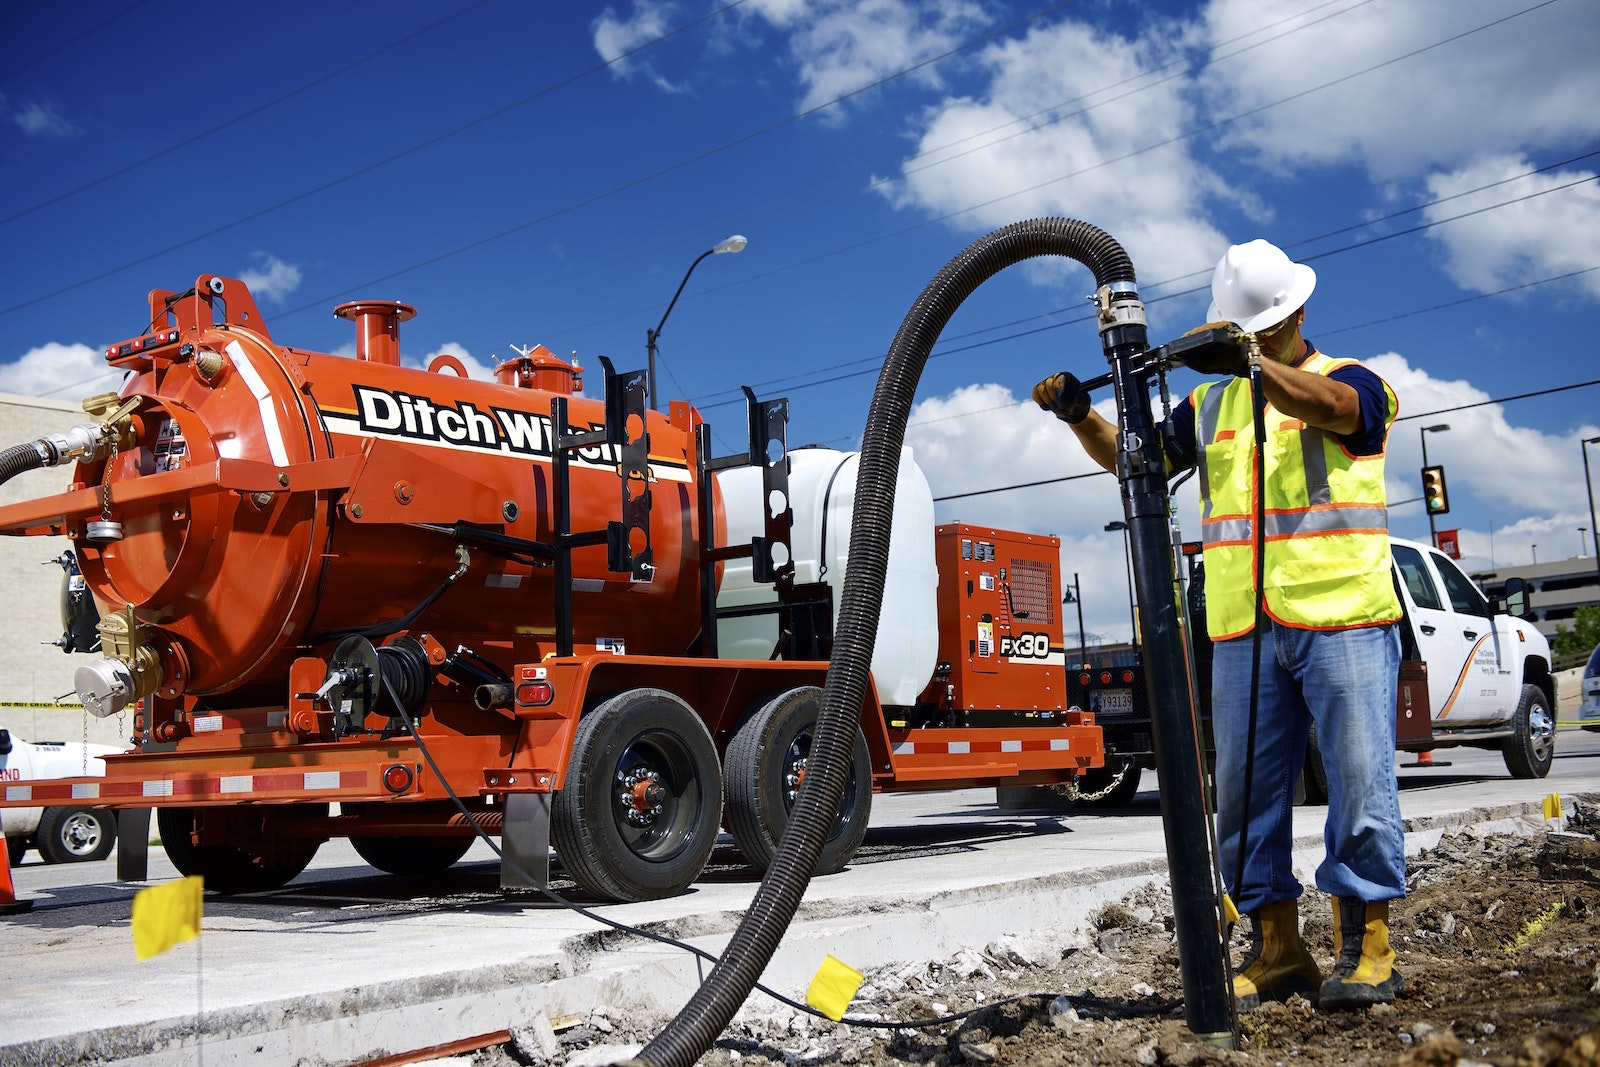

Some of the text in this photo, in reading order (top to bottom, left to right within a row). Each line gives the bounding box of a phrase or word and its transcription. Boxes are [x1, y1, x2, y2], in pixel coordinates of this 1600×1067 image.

[357, 387, 623, 464] Ditch Wich
[1001, 634, 1049, 656] FX30
